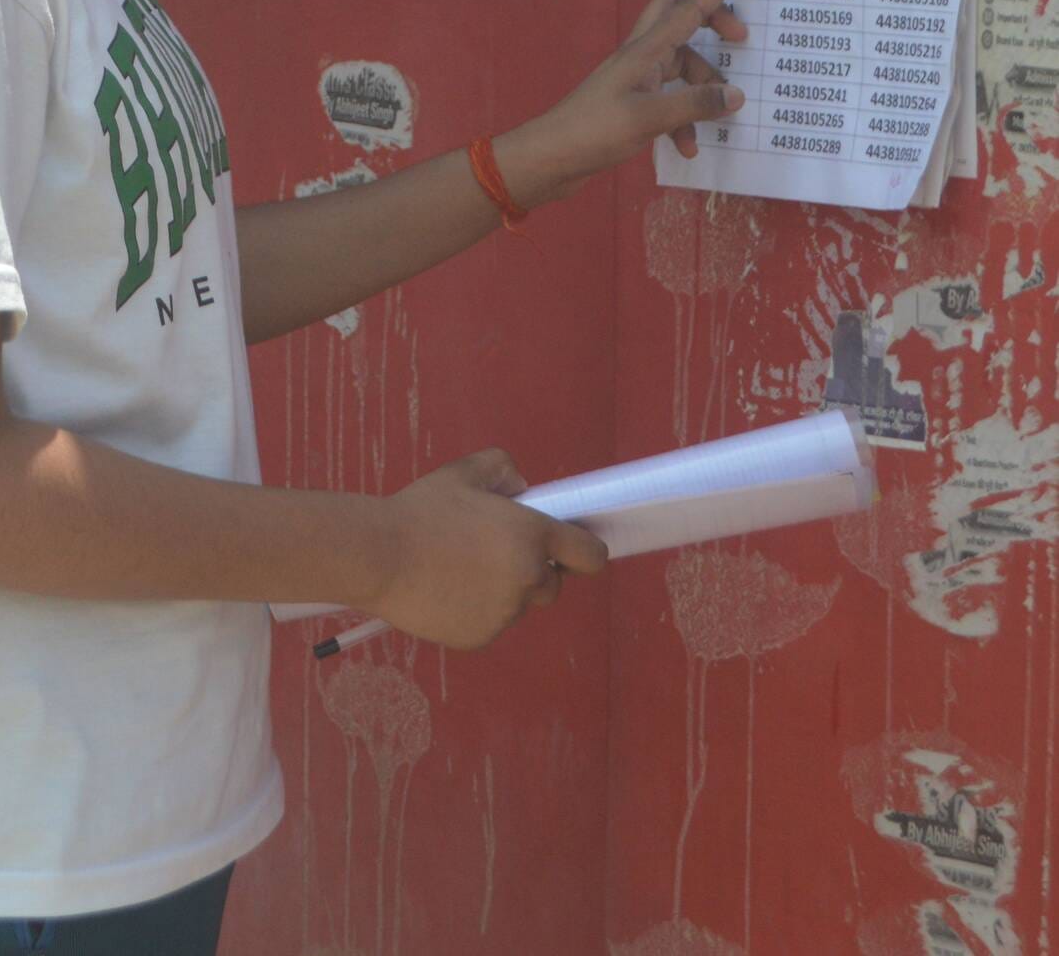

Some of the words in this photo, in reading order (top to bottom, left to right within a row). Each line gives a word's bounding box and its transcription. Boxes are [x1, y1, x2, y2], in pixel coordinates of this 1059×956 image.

[779, 7, 853, 25] 4438105169
[875, 14, 945, 33] 4438105192
[777, 32, 851, 51] 4438105193
[874, 41, 942, 59] 4438105216
[717, 53, 731, 67] 33
[776, 58, 851, 77] 4438105217
[873, 66, 940, 85] 4438105240
[774, 83, 847, 103] 4438105241
[870, 92, 937, 111] 4438105264
[772, 108, 844, 128] 4438105265
[771, 134, 841, 155] 4438105289
[948, 289, 965, 312] By
[907, 821, 923, 843] By
